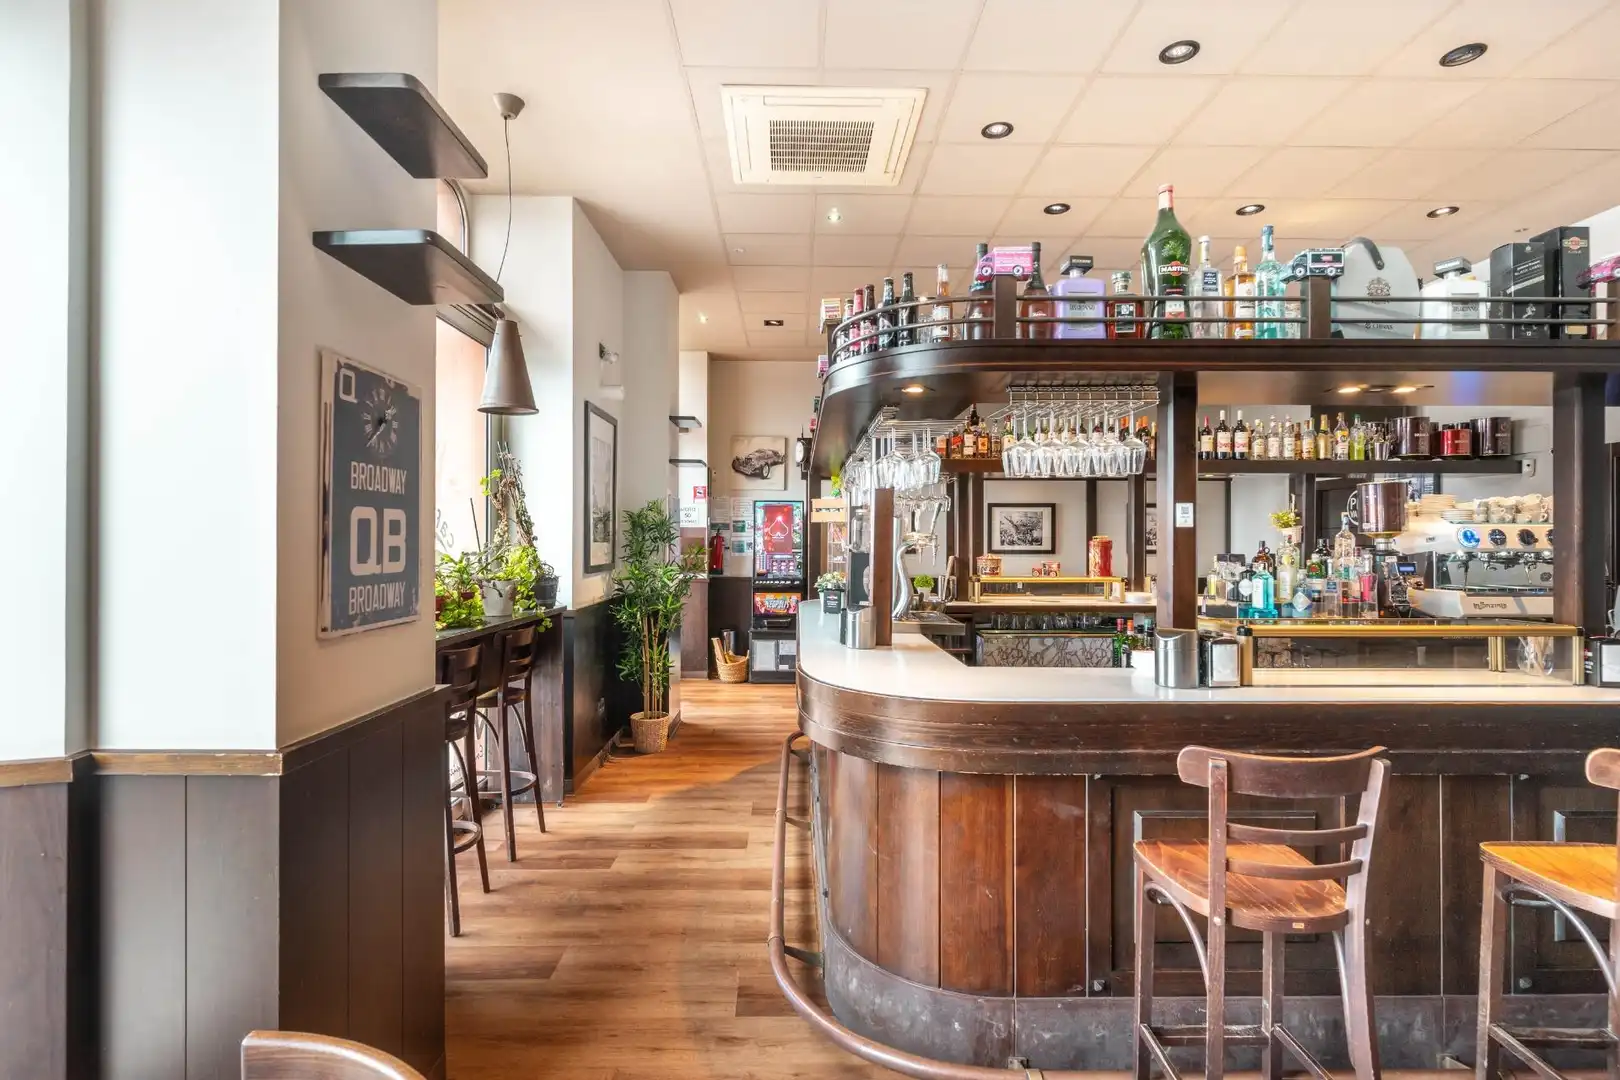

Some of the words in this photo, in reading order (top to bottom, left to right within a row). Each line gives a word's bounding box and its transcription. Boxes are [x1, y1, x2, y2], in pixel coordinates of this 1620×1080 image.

[340, 367, 358, 403] Q
[350, 461, 407, 495] BROADWAY
[349, 506, 407, 576] QB
[349, 582, 406, 616] BROADWAY
